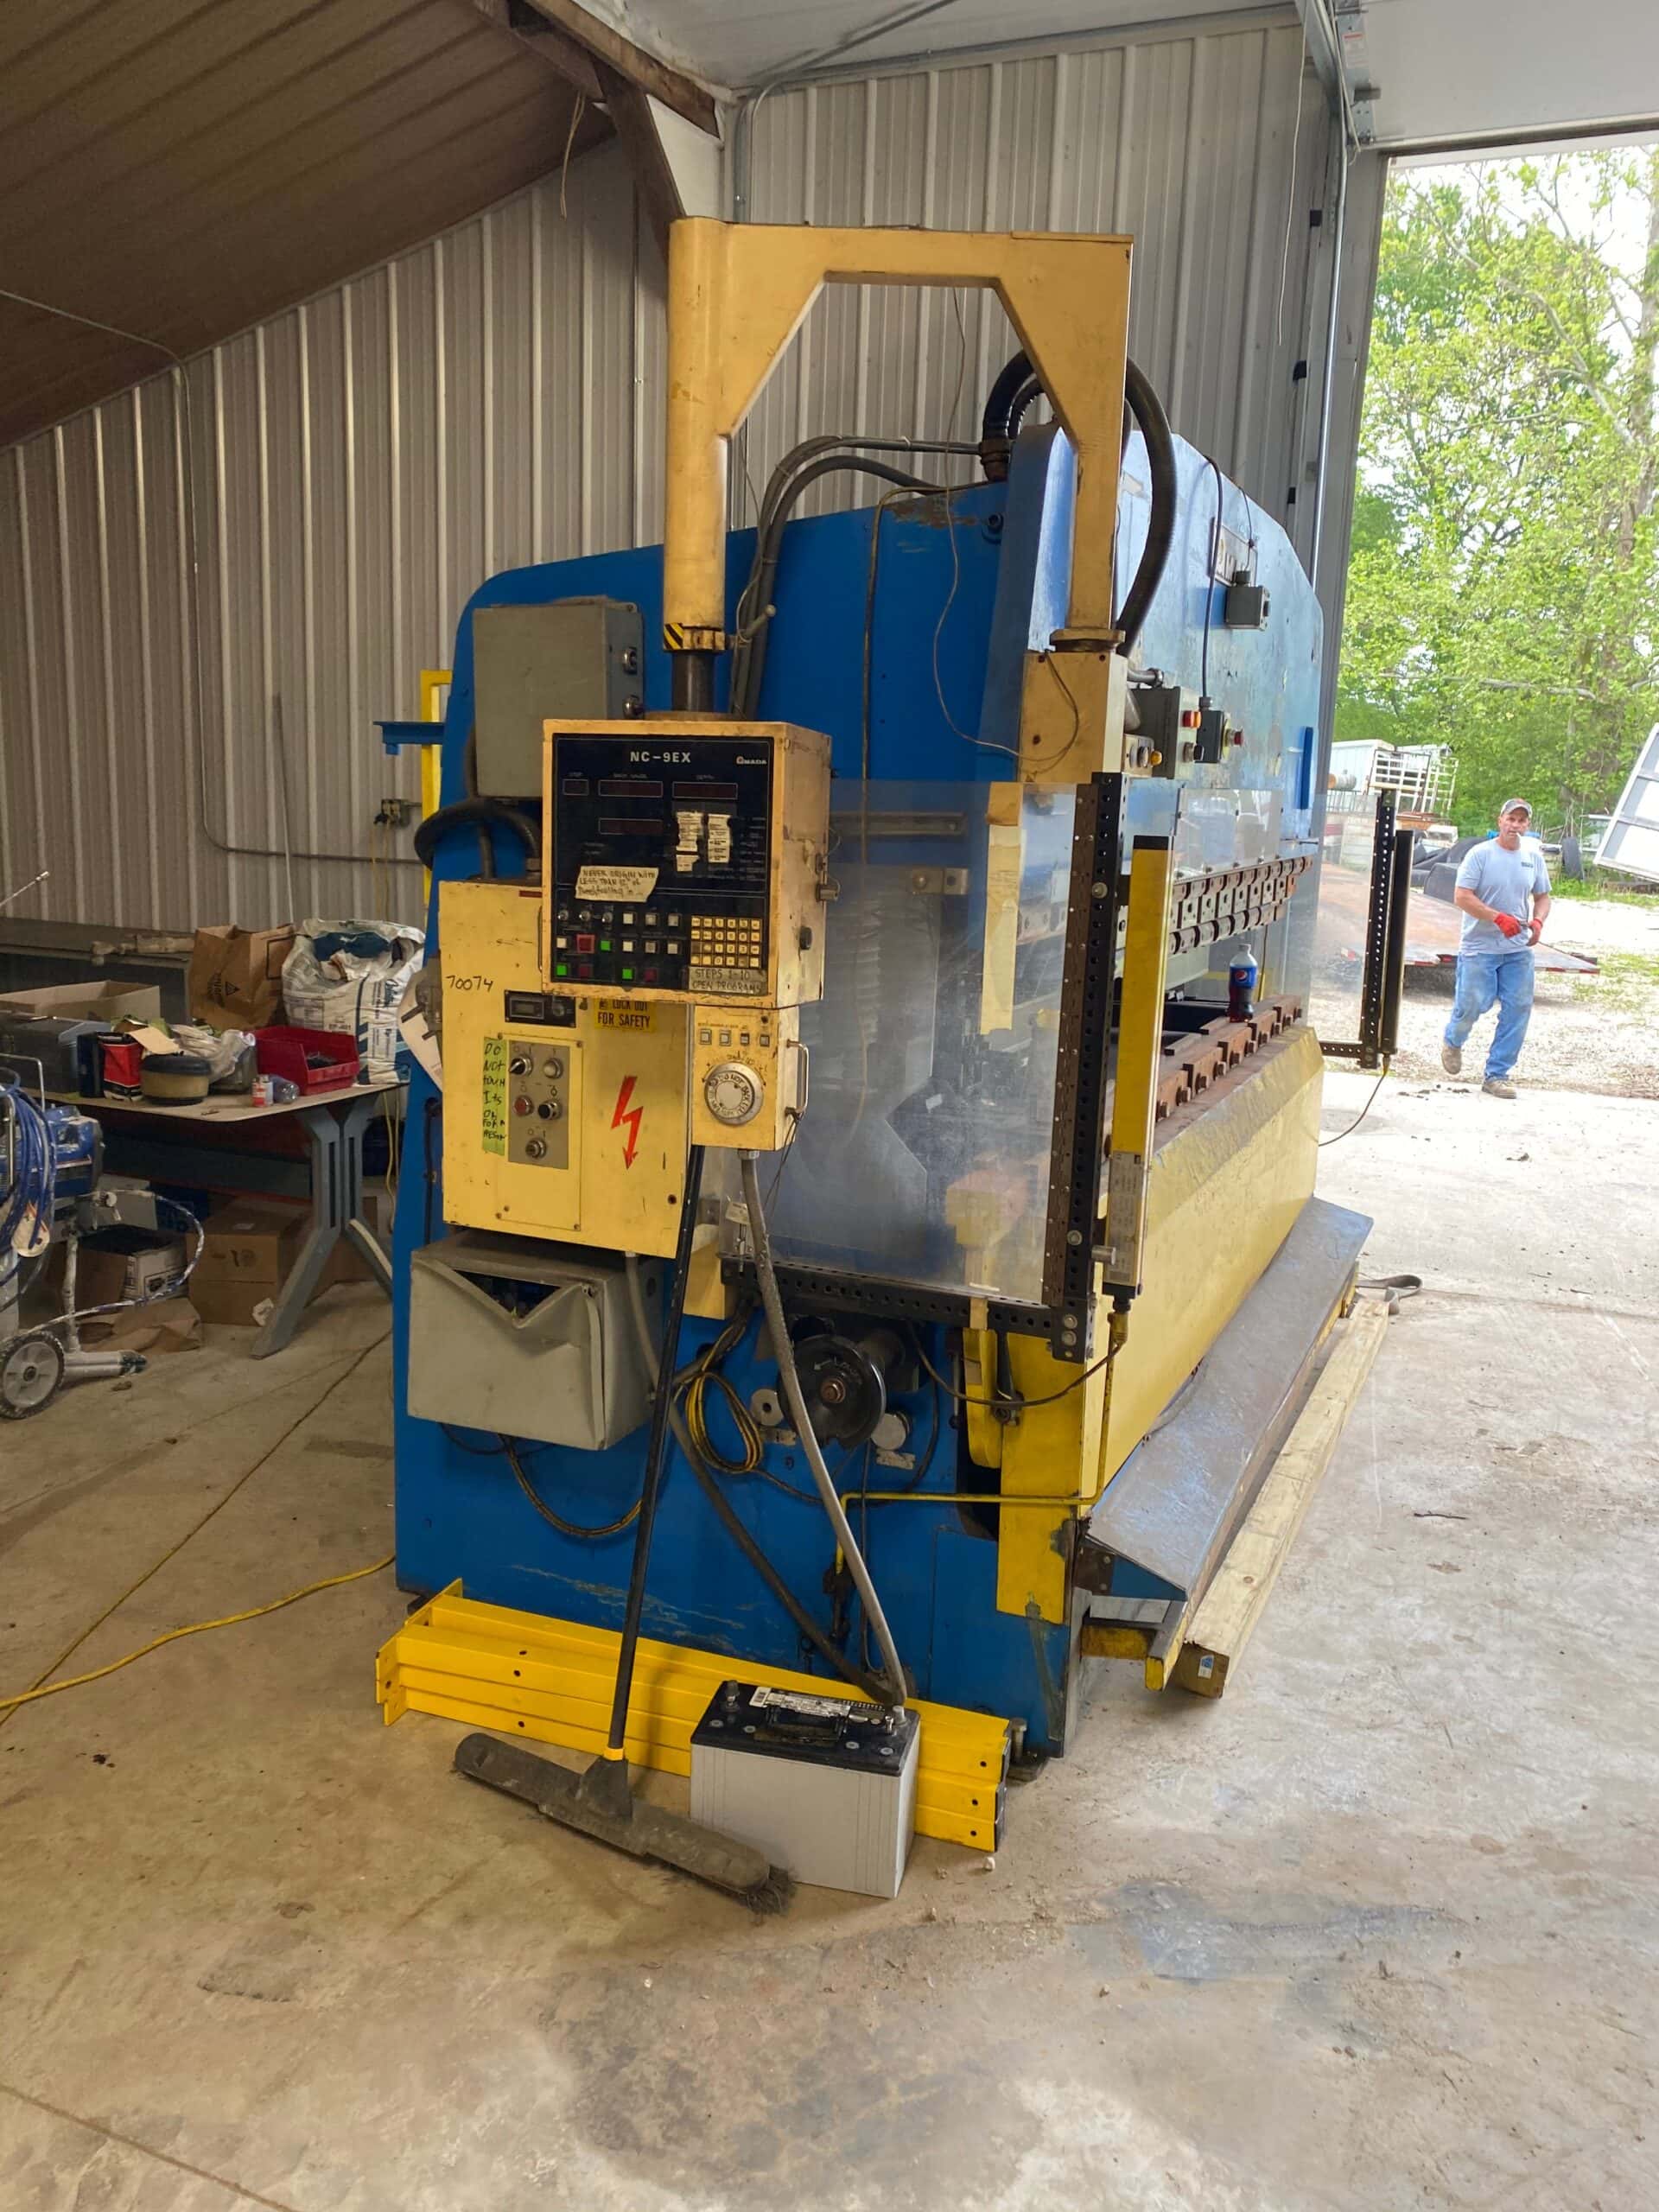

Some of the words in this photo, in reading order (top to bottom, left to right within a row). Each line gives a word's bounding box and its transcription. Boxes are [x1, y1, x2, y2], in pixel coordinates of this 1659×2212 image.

[630, 751, 691, 763] NC-9EX
[695, 968, 723, 979] STEPS
[445, 975, 493, 993] 70074
[692, 981, 714, 991] OPEN
[597, 1011, 614, 1025] FOR
[619, 1014, 651, 1028] SAFETY
[484, 1043, 501, 1055] DO
